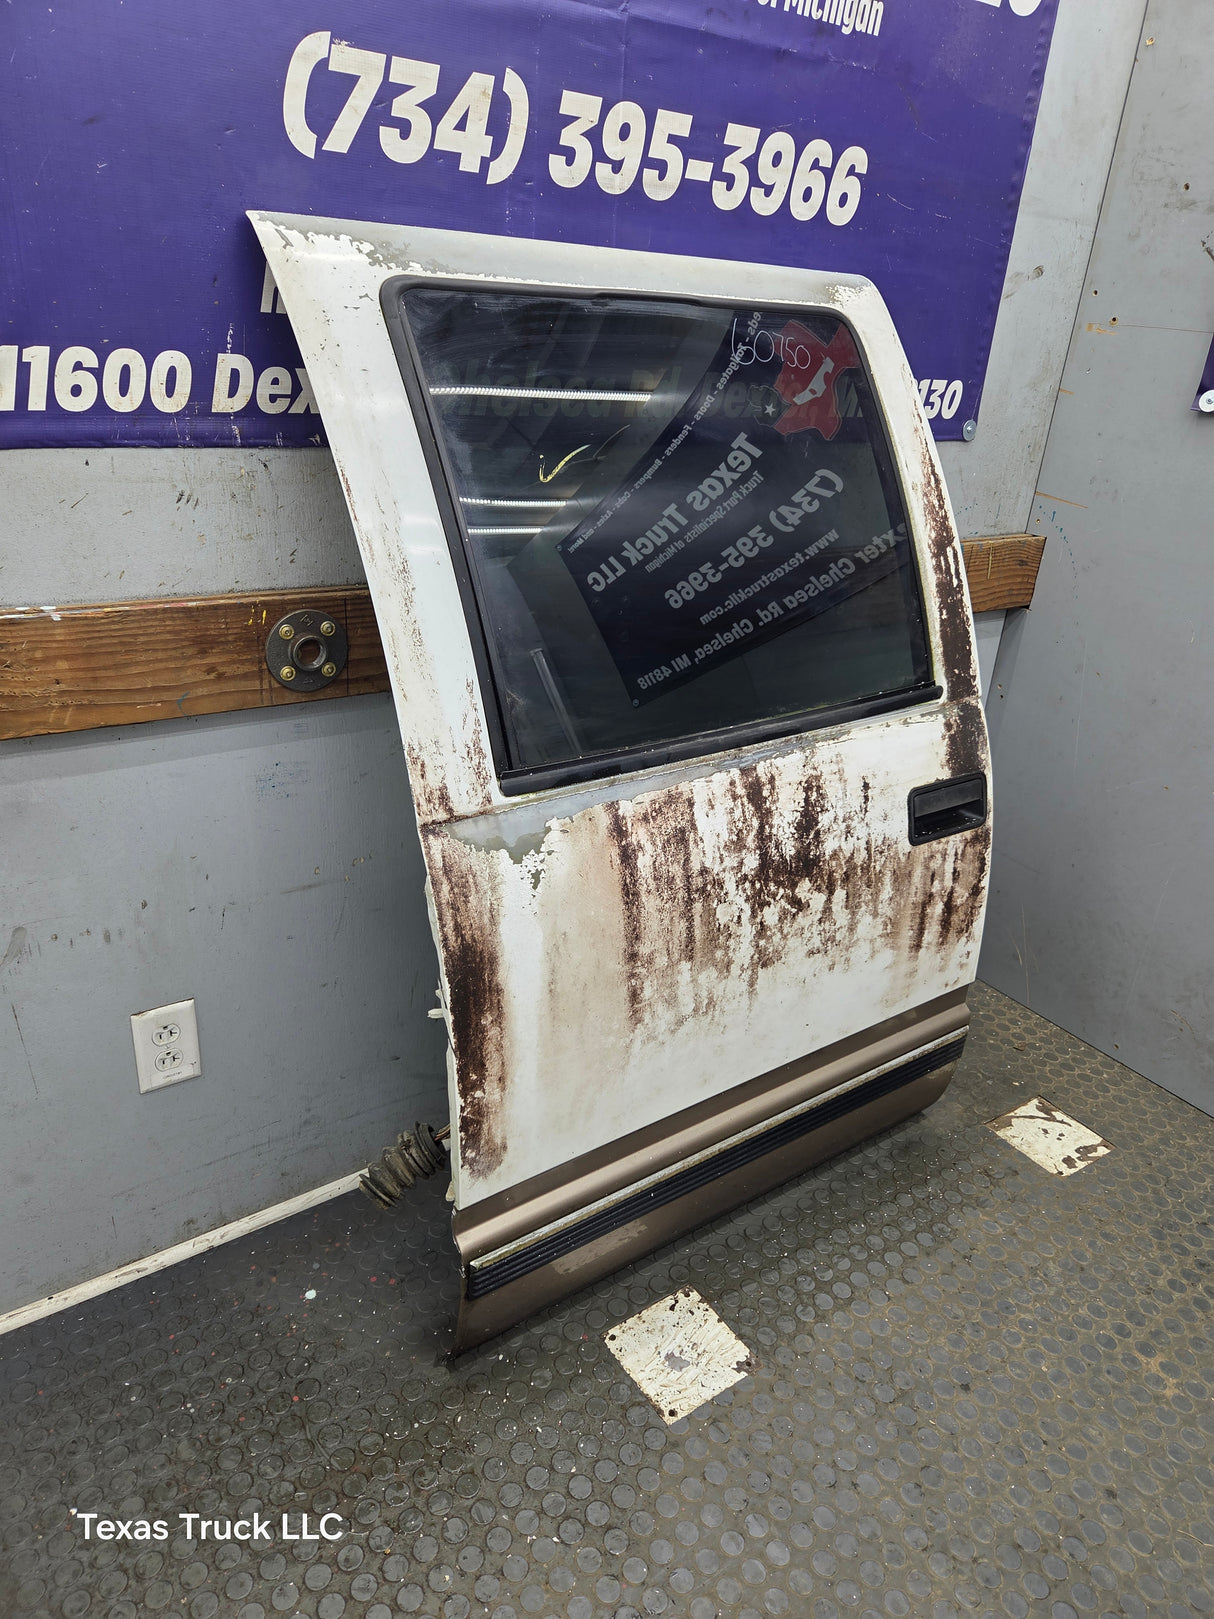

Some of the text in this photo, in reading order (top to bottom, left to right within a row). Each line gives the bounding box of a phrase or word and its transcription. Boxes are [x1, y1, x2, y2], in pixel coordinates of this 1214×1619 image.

[283, 31, 868, 227] (734) 395-3966
[0, 344, 193, 414] 11600
[211, 352, 320, 415] Dex
[918, 378, 964, 420] 130
